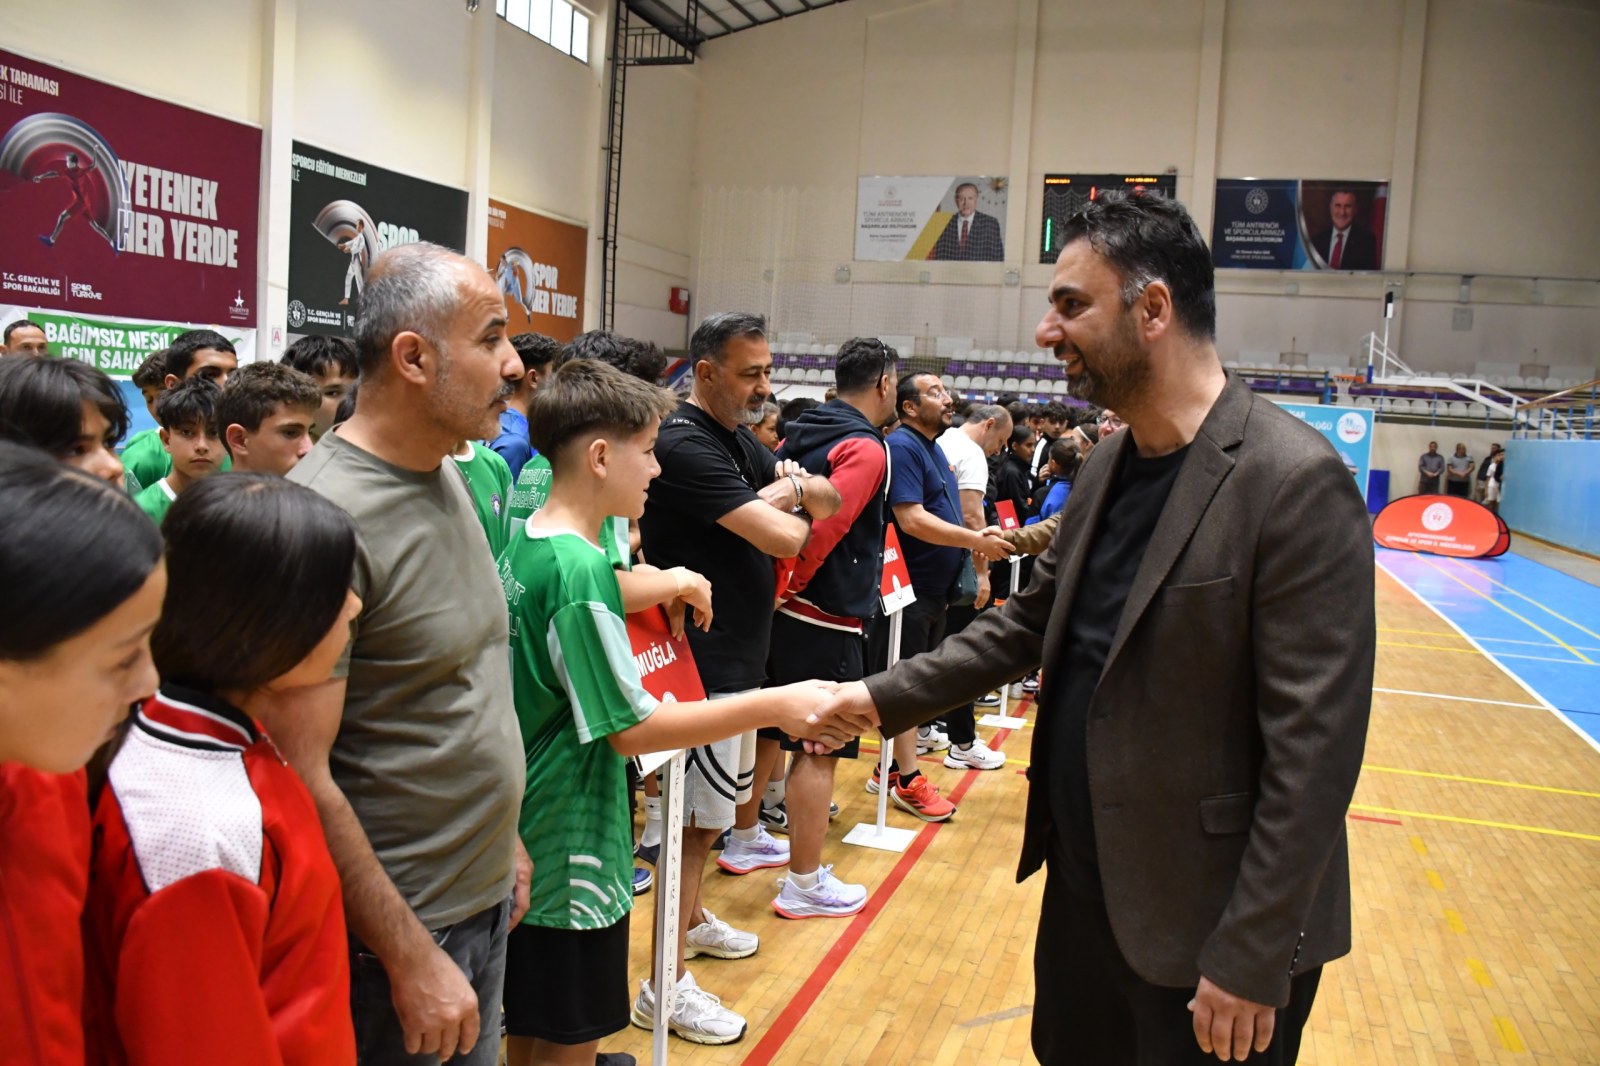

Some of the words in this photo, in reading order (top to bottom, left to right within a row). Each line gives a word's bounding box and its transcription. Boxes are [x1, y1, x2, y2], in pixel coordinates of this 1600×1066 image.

[9, 67, 59, 97] TARAMASI
[9, 84, 23, 106] İLE
[292, 153, 315, 171] SPORCU
[117, 158, 218, 221] YETENEK
[1231, 220, 1245, 228] TÜM
[117, 208, 165, 258] HER
[170, 218, 239, 269] YERDE
[2, 272, 17, 281] T.C.
[17, 274, 50, 286] GENÇLİK
[50, 279, 60, 287] VE
[2, 281, 22, 291] SPOR
[23, 284, 60, 296] BAKANLIĞI
[533, 262, 558, 290] SPOR
[551, 292, 577, 319] YERDE
[45, 321, 126, 348] BAĞIMSIZ
[100, 349, 149, 370] SAHA
[633, 641, 677, 678] MUĞLA
